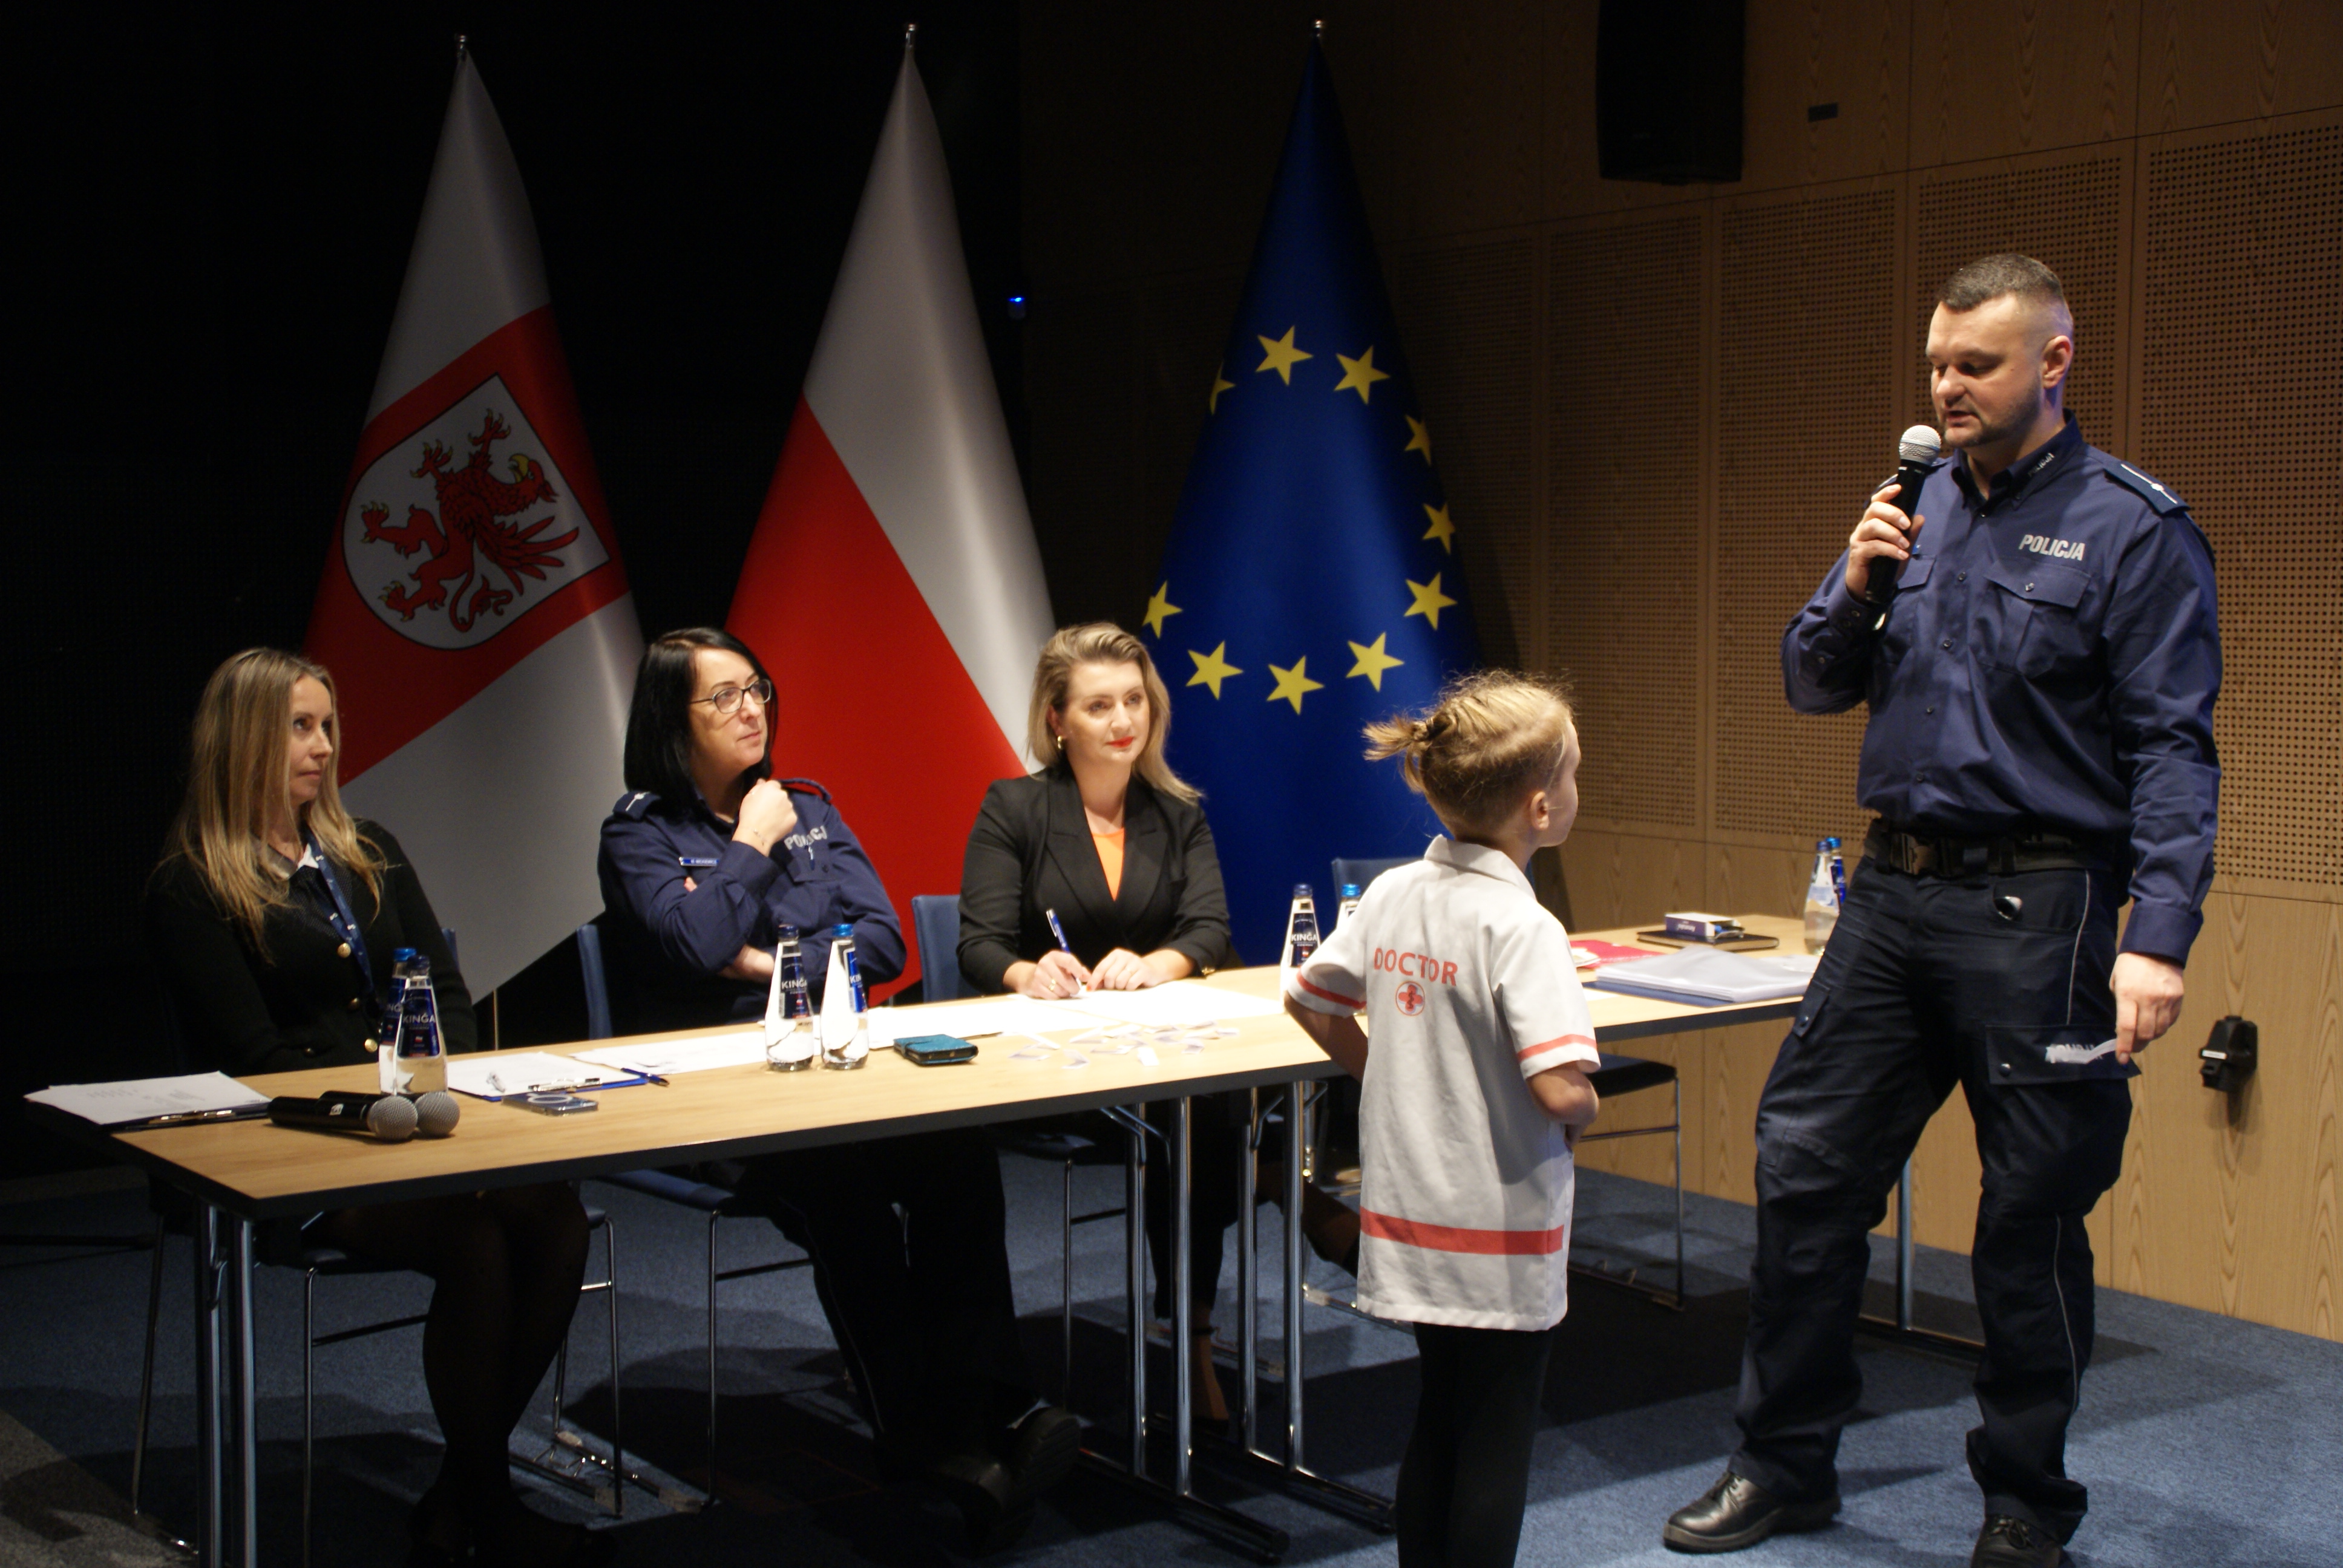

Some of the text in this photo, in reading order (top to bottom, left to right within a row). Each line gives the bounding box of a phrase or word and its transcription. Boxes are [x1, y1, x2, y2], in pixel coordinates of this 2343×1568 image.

[2018, 534, 2086, 561] POLICJA
[784, 825, 828, 851] POLICJ
[1374, 947, 1458, 987] DOCTOR
[402, 1013, 436, 1024] KINGA
